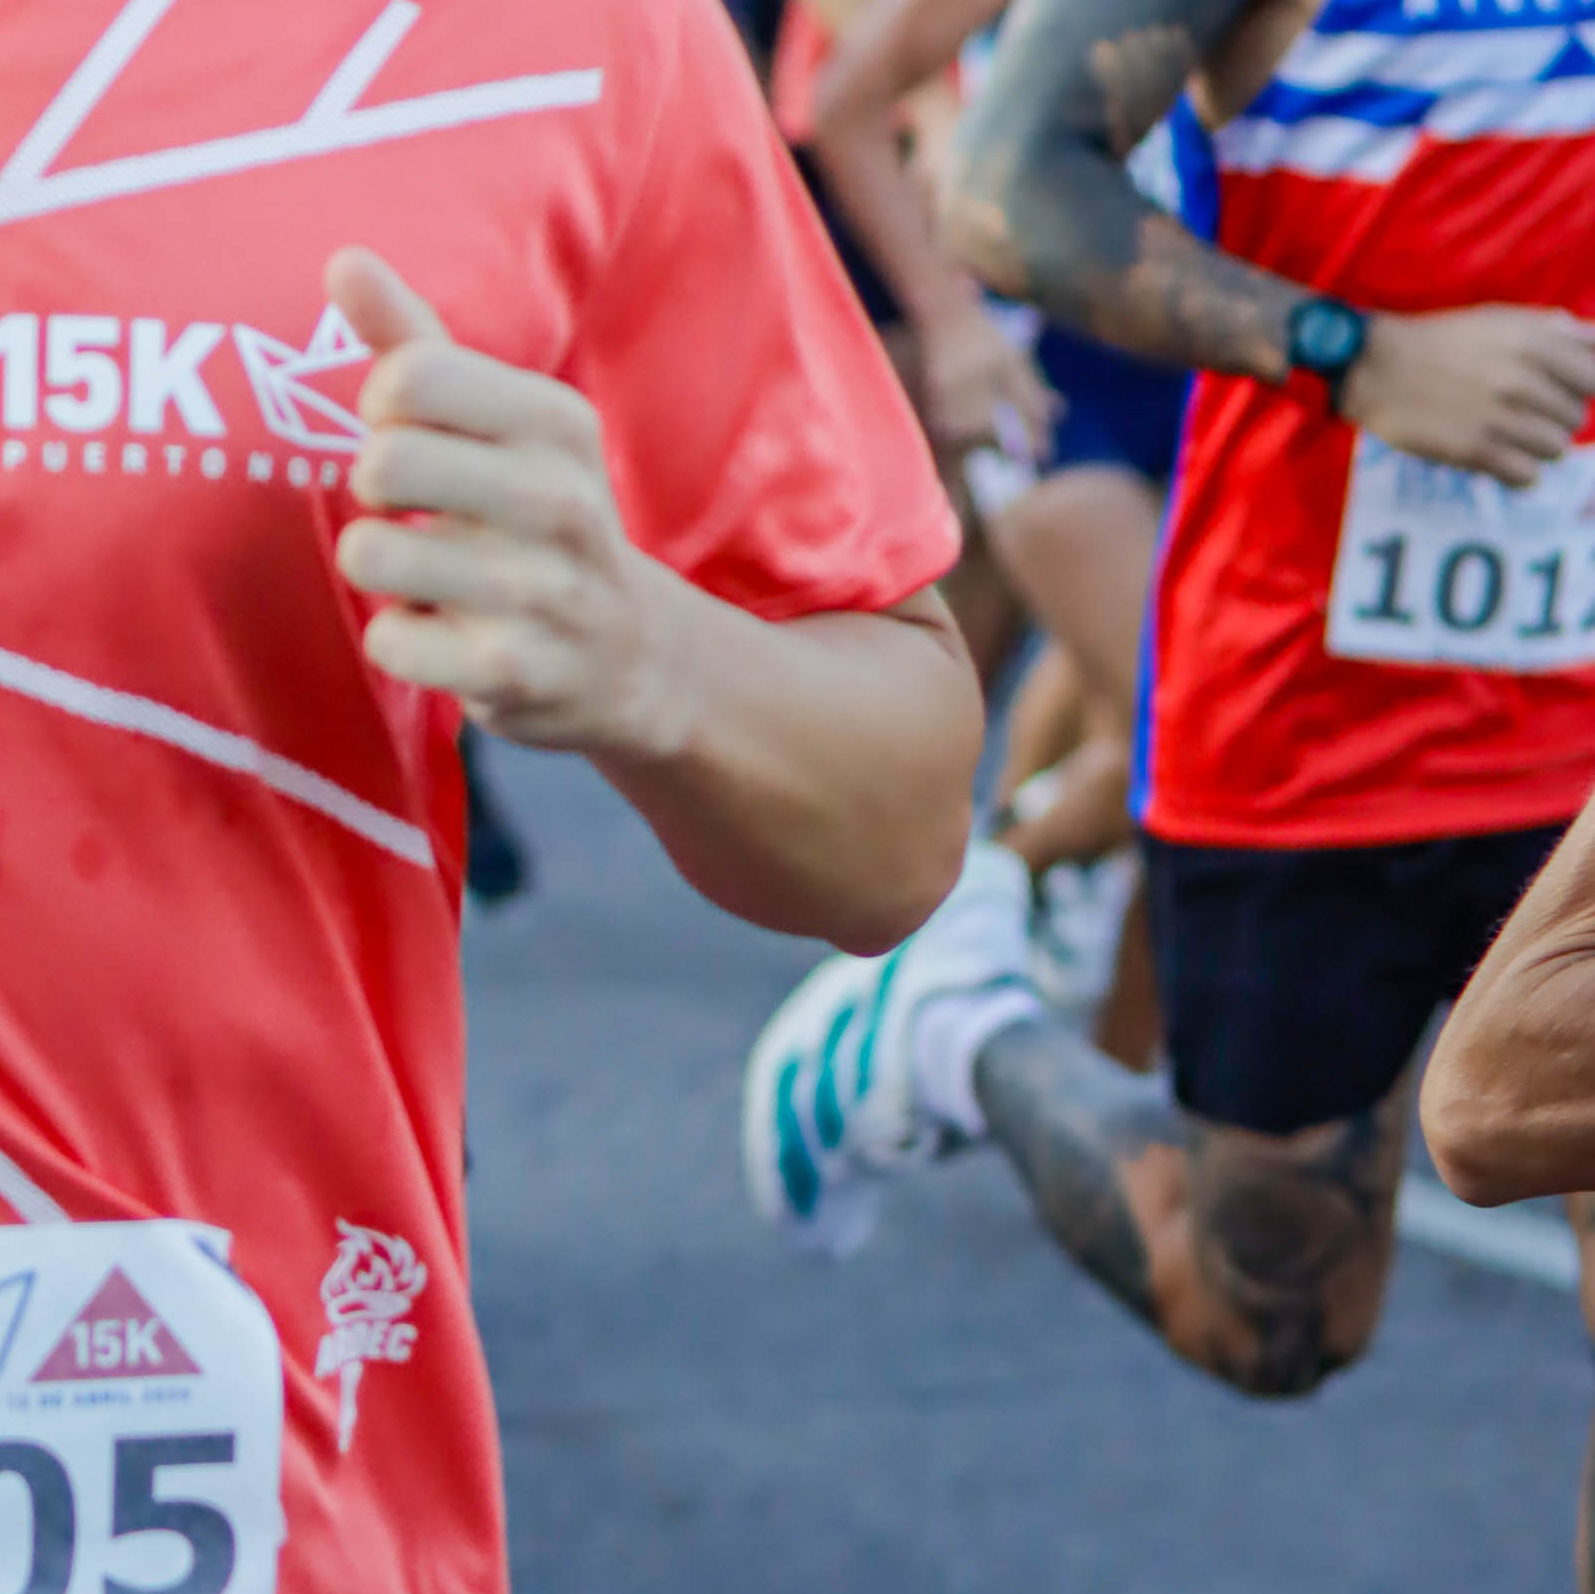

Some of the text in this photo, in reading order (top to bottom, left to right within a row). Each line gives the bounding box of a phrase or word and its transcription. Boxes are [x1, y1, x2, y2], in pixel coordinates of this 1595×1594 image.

[2, 440, 227, 481] PUERTO
[1354, 533, 1595, 641] 101
[70, 1316, 164, 1369] 15K
